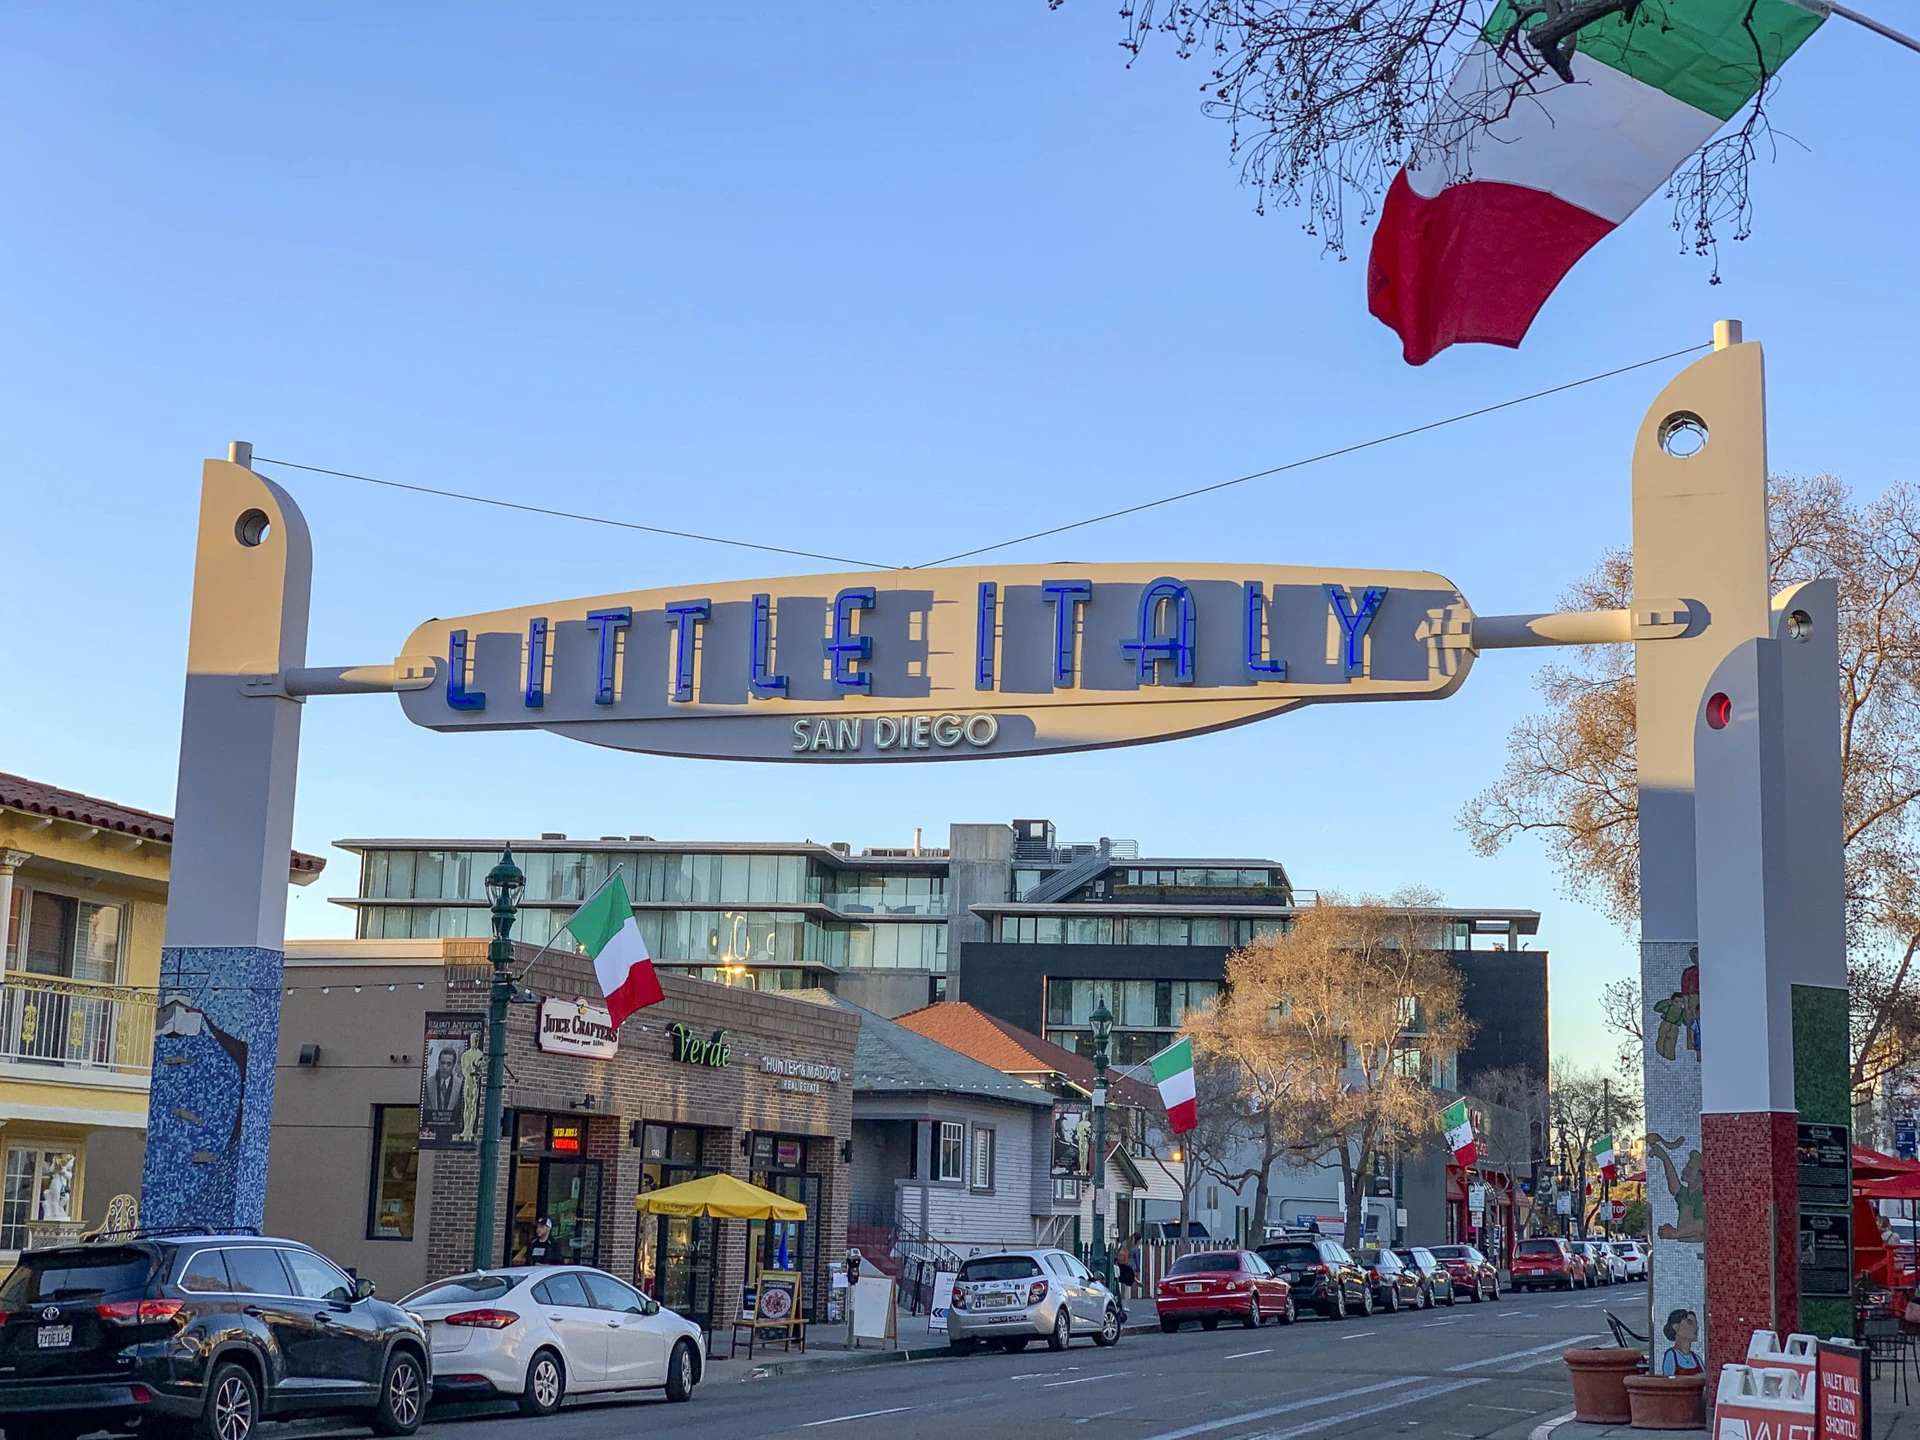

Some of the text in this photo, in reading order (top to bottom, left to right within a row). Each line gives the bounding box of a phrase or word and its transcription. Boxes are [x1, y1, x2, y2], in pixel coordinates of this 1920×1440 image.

[445, 576, 1389, 711] LITTLE ITALY
[791, 712, 999, 752] SAN DIEGO
[543, 1013, 618, 1043] JUICE CRAFTERS
[672, 1022, 731, 1068] Verde
[766, 1057, 841, 1083] HUNTER & MADDOX
[783, 1079, 820, 1094] REAL ESTATE
[1611, 1205, 1625, 1214] TOP
[1822, 1371, 1842, 1391] VALET
[1843, 1376, 1860, 1395] WILL
[1828, 1394, 1855, 1416] RETURN
[1825, 1415, 1858, 1439] SHORTLY.
